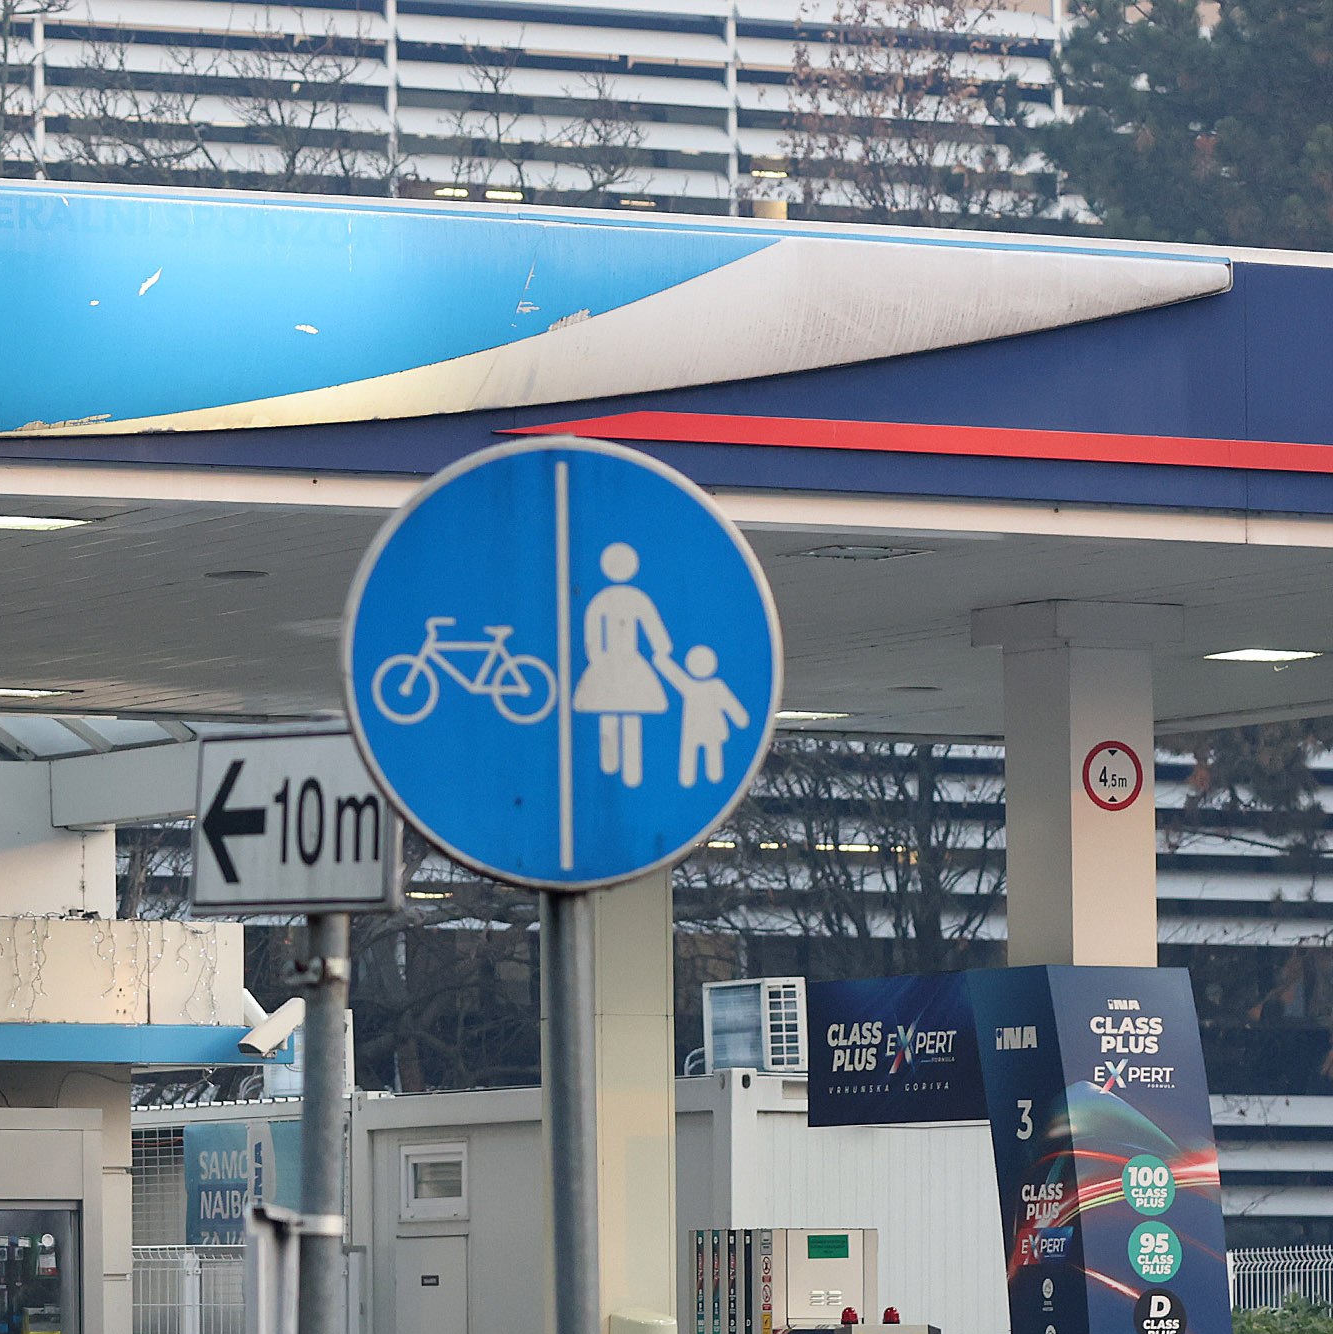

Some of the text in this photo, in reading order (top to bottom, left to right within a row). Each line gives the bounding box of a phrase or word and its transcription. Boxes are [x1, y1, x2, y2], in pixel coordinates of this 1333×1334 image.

[1107, 999, 1141, 1010] INA
[827, 1021, 883, 1047] CLASS
[1090, 1016, 1163, 1035] CLASS
[996, 1026, 1038, 1050] INA
[1101, 1035, 1159, 1054] PLUS
[886, 1024, 957, 1074] EXPERT
[832, 1047, 877, 1072] PLUS
[1094, 1059, 1174, 1094] EXPERT
[828, 1081, 950, 1094] VRHUNSKA GORIVA
[1016, 1099, 1033, 1140] 3
[1128, 1166, 1169, 1187] 100
[1021, 1183, 1064, 1202] CLASS
[1131, 1188, 1168, 1198] CLASS
[1026, 1202, 1060, 1220] PLUS
[1136, 1198, 1165, 1208] PLUS
[1021, 1234, 1066, 1265] EXPERT
[1139, 1233, 1169, 1254] 95
[1137, 1255, 1174, 1265] CLASS
[1142, 1265, 1171, 1275] PLUS
[1149, 1295, 1171, 1318] D
[1143, 1319, 1180, 1329] CLASS
